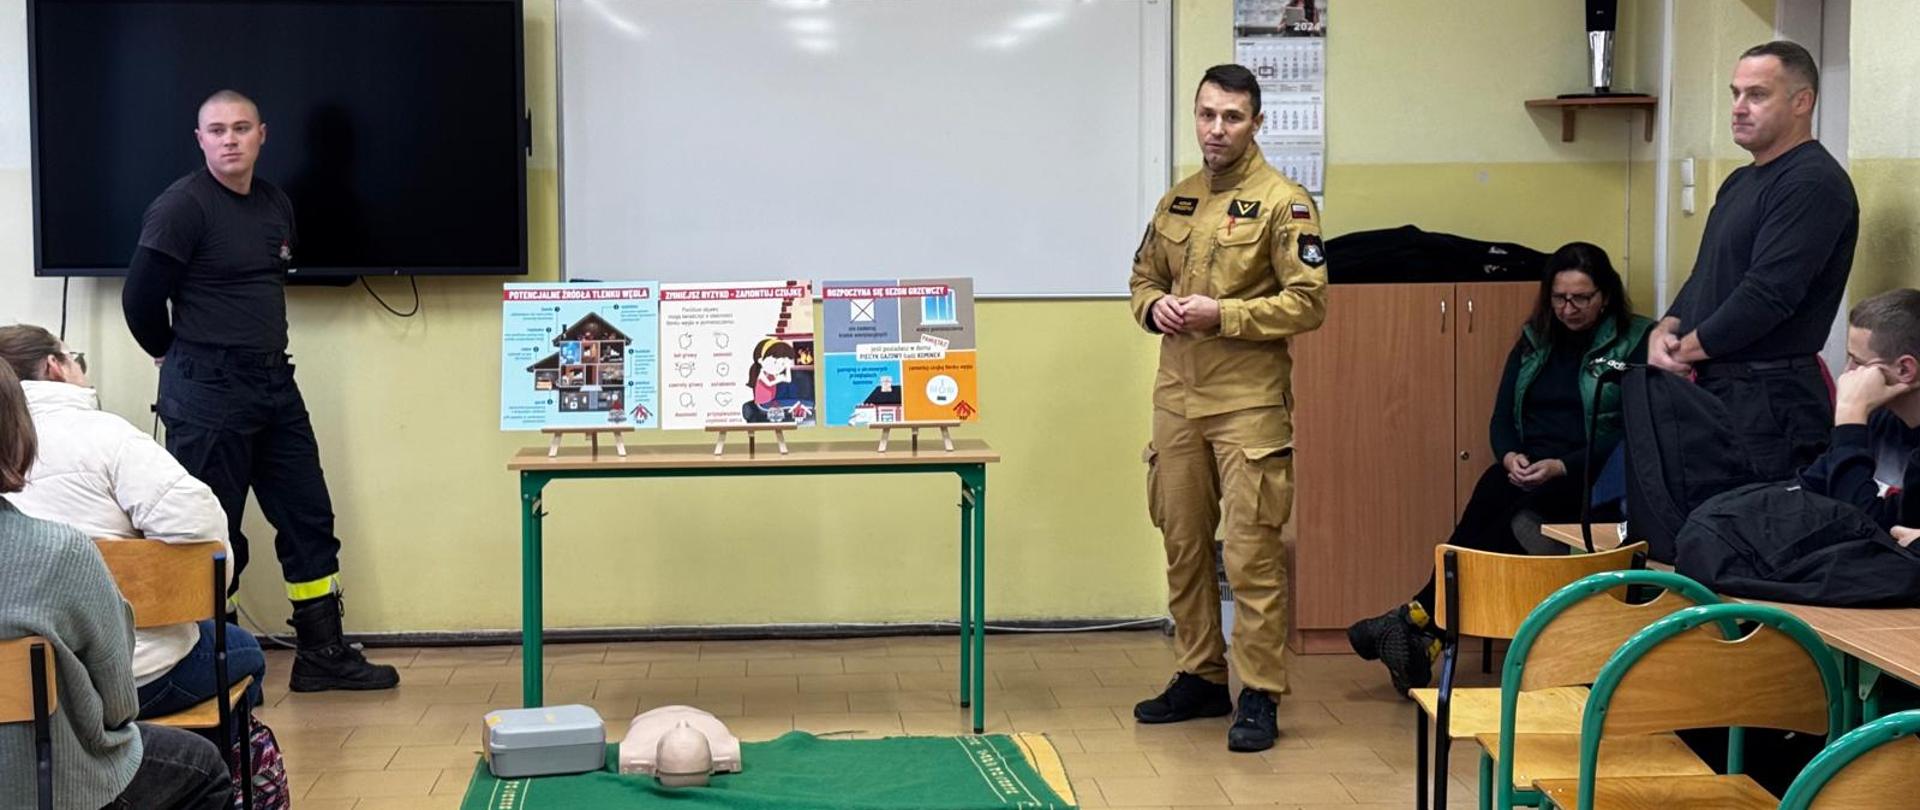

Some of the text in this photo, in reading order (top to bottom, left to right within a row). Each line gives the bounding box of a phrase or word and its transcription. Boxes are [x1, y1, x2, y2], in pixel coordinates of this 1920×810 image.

[1293, 22, 1320, 31] 2024
[508, 290, 560, 300] POTENCJALNE
[592, 289, 622, 299] TLENKU
[622, 289, 648, 300] WĘGLA
[665, 291, 701, 300] ZMNIEJSZ
[702, 290, 729, 299] RYZYKO
[735, 289, 774, 299] ZAMONTUJ
[826, 286, 944, 298] ROZPOCZYNA SIĘ SEZON GRZEWCZY
